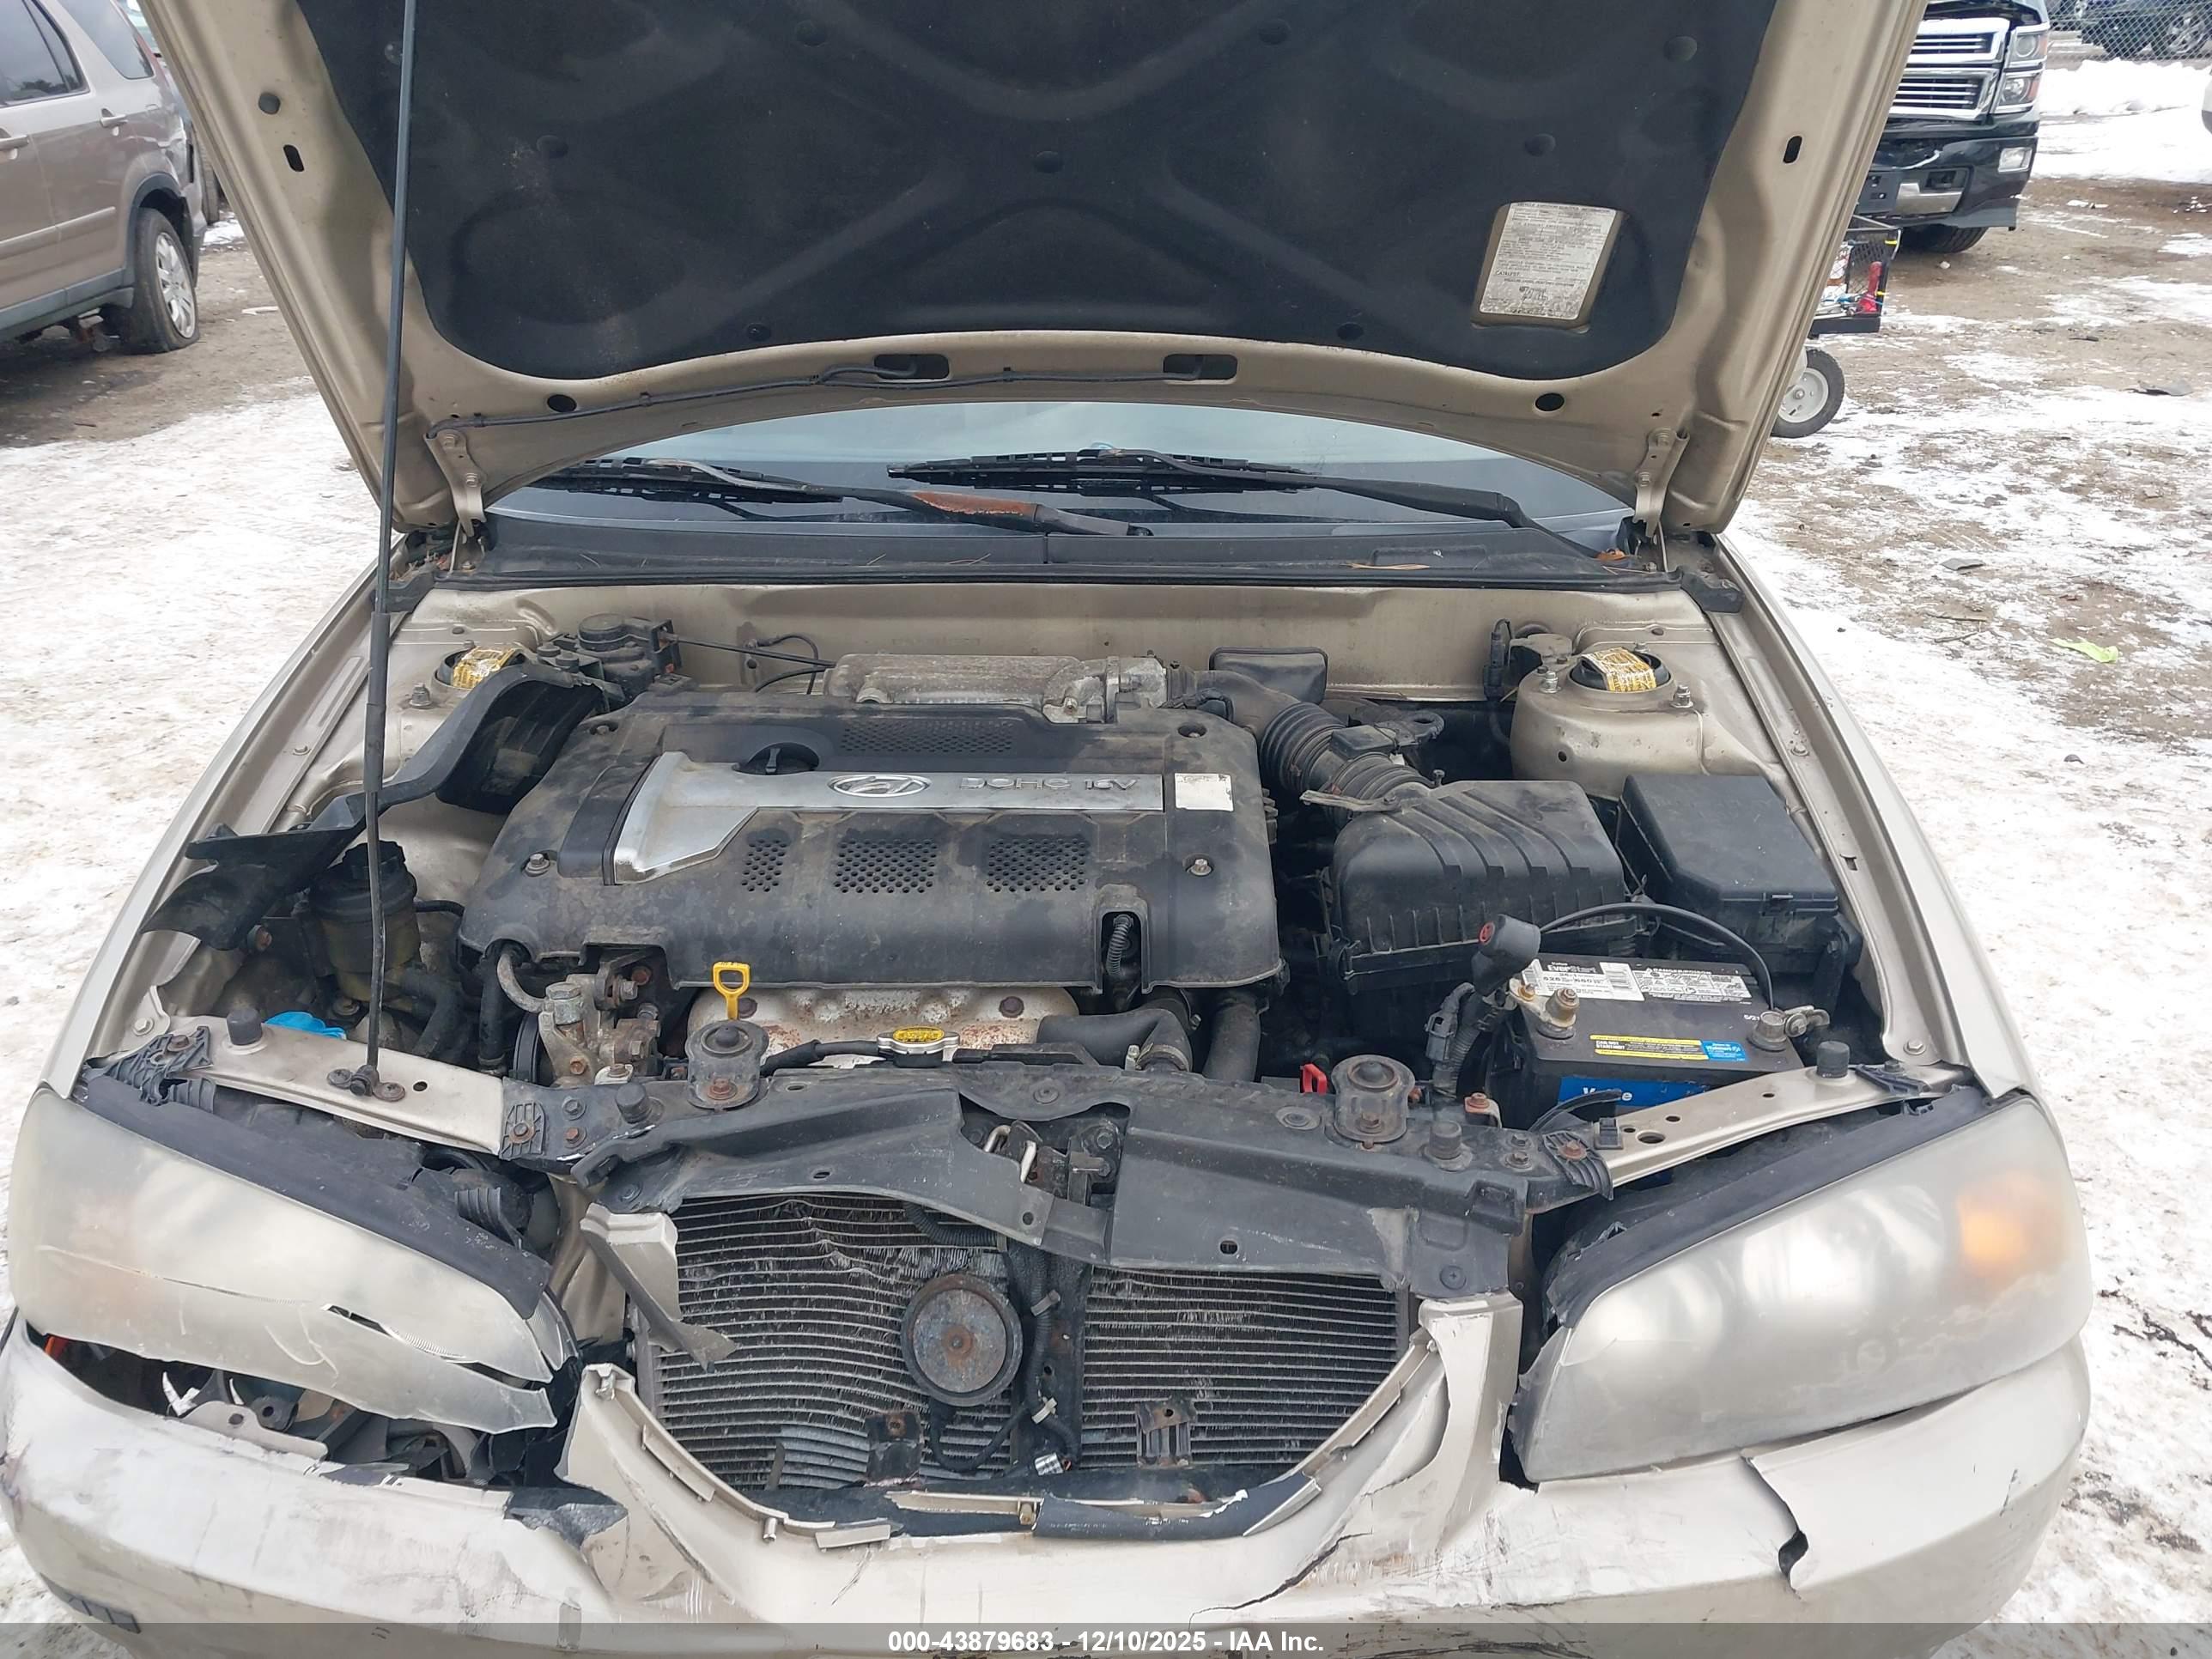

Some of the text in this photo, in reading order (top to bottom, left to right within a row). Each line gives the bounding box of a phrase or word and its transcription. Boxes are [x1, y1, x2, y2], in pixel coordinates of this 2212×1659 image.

[959, 776, 1139, 791] DOHC 16V
[1547, 964, 1597, 974] EverStart
